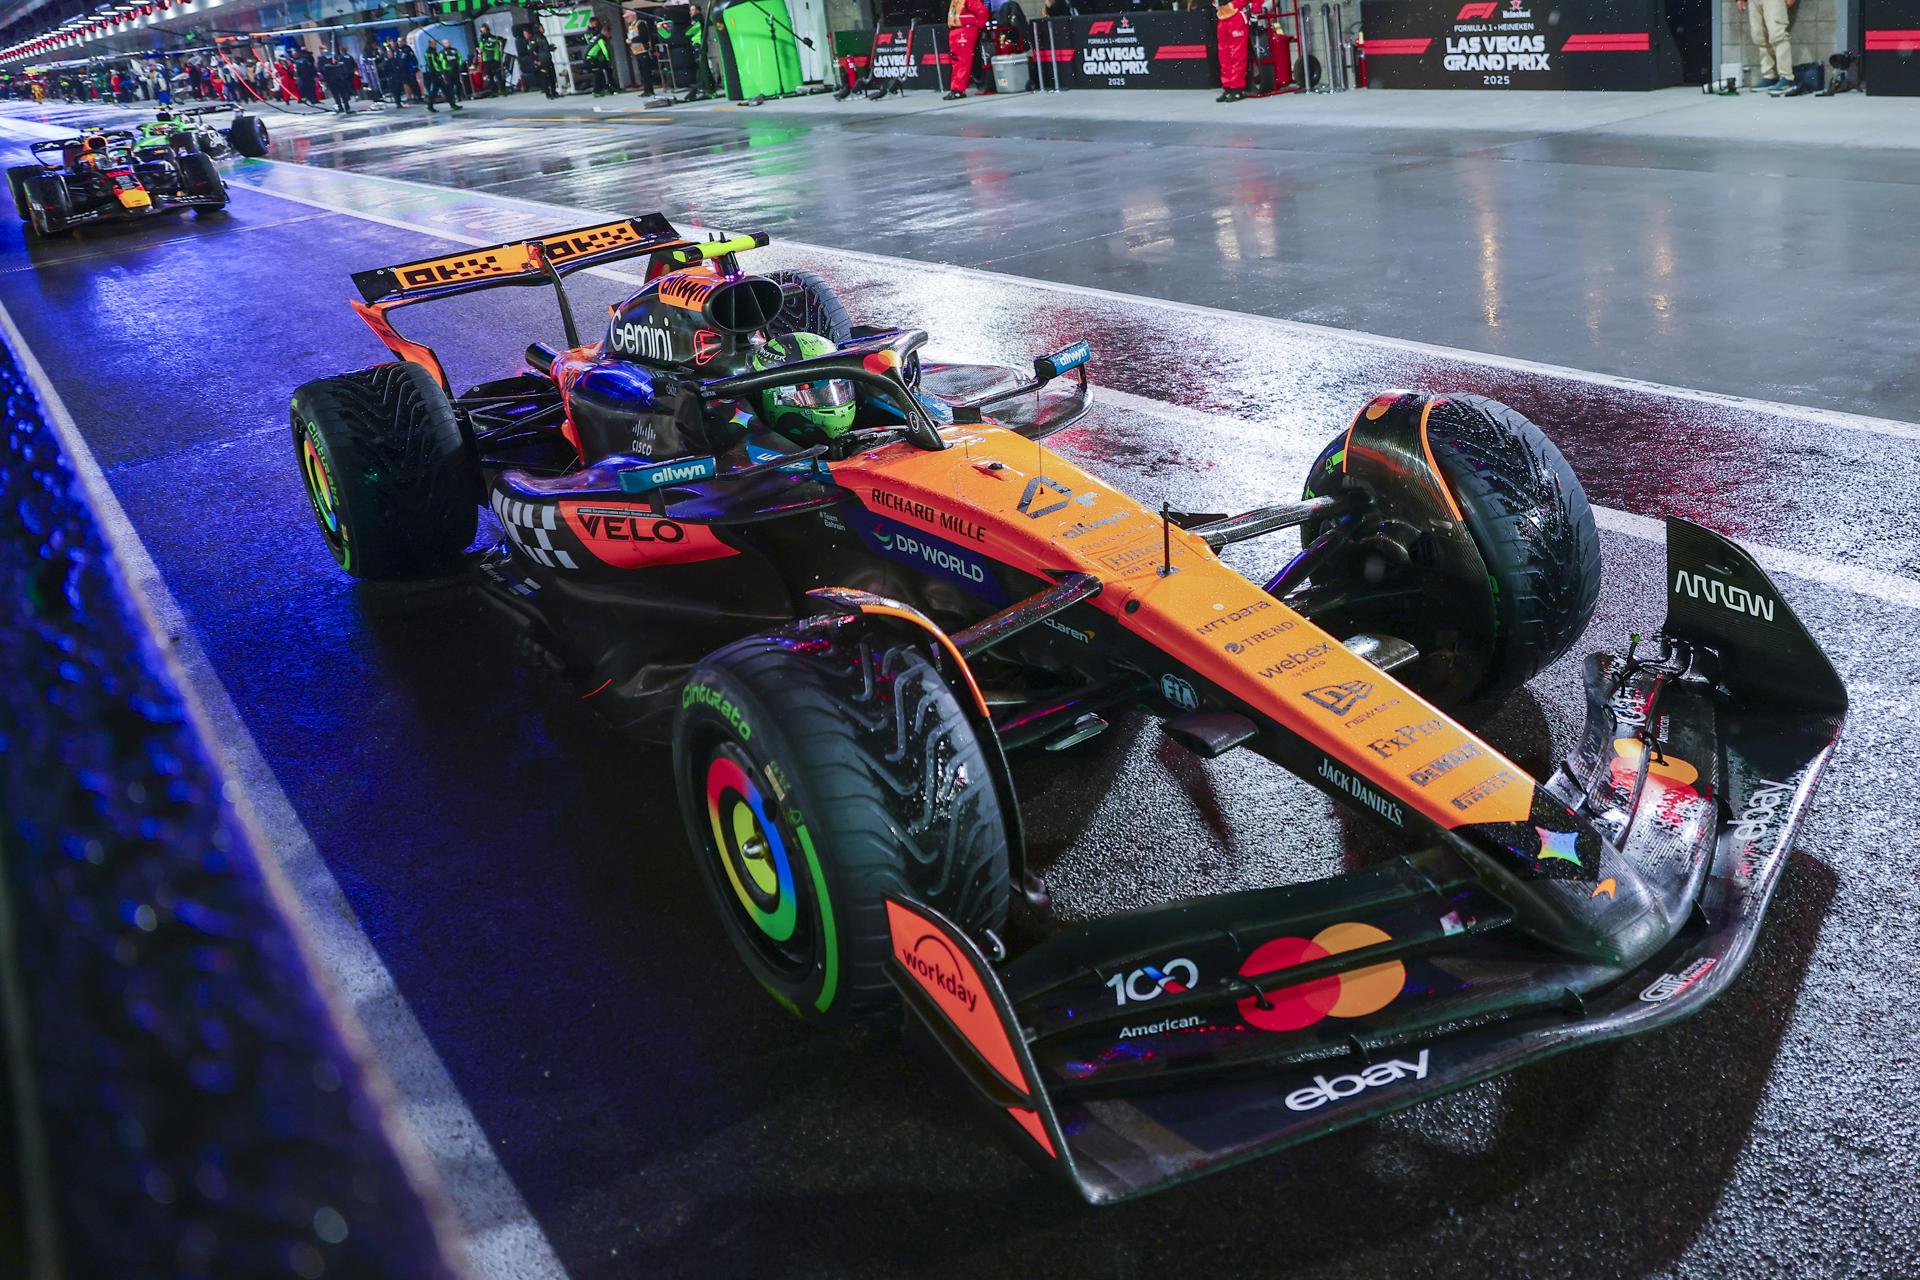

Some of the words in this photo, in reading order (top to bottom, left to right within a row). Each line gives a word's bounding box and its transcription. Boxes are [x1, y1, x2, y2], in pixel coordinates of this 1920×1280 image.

[564, 9, 592, 30] 27
[1454, 24, 1487, 32] FORMULA
[1498, 23, 1534, 31] HEINEKEN
[1083, 48, 1106, 61] LAS
[1106, 46, 1145, 60] VEGAS
[1445, 37, 1481, 53] LAS
[1482, 35, 1546, 53] VEGAS
[1083, 62, 1120, 75] GRAND
[1121, 61, 1149, 74] PRIX
[1443, 54, 1506, 71] GRAND
[1506, 54, 1551, 71] PRIX
[1108, 78, 1125, 86] 2025
[1483, 76, 1510, 85] 2025
[551, 227, 634, 258] OKX
[403, 255, 502, 286] OKX
[610, 310, 673, 361] Gemini
[652, 464, 706, 484] allwyn
[577, 513, 684, 543] VELO
[872, 488, 935, 523] RICHARD
[940, 512, 986, 543] MILLE
[896, 534, 918, 555] DP
[920, 543, 984, 583] WORLD
[1675, 570, 1774, 621] ARROW
[1042, 618, 1088, 644] cLaren
[1196, 615, 1227, 635] NTT
[1258, 641, 1334, 679] webex
[1163, 678, 1197, 709] FIA
[682, 683, 751, 740] Cinturato
[1657, 714, 1669, 744] American
[1318, 758, 1349, 792] JACK
[1351, 776, 1404, 827] DANIEL'S
[1727, 779, 1797, 840] ebay
[903, 948, 977, 1013] workday
[1105, 958, 1199, 1006] 100
[1119, 1016, 1199, 1039] American
[1284, 1048, 1429, 1112] ebay
